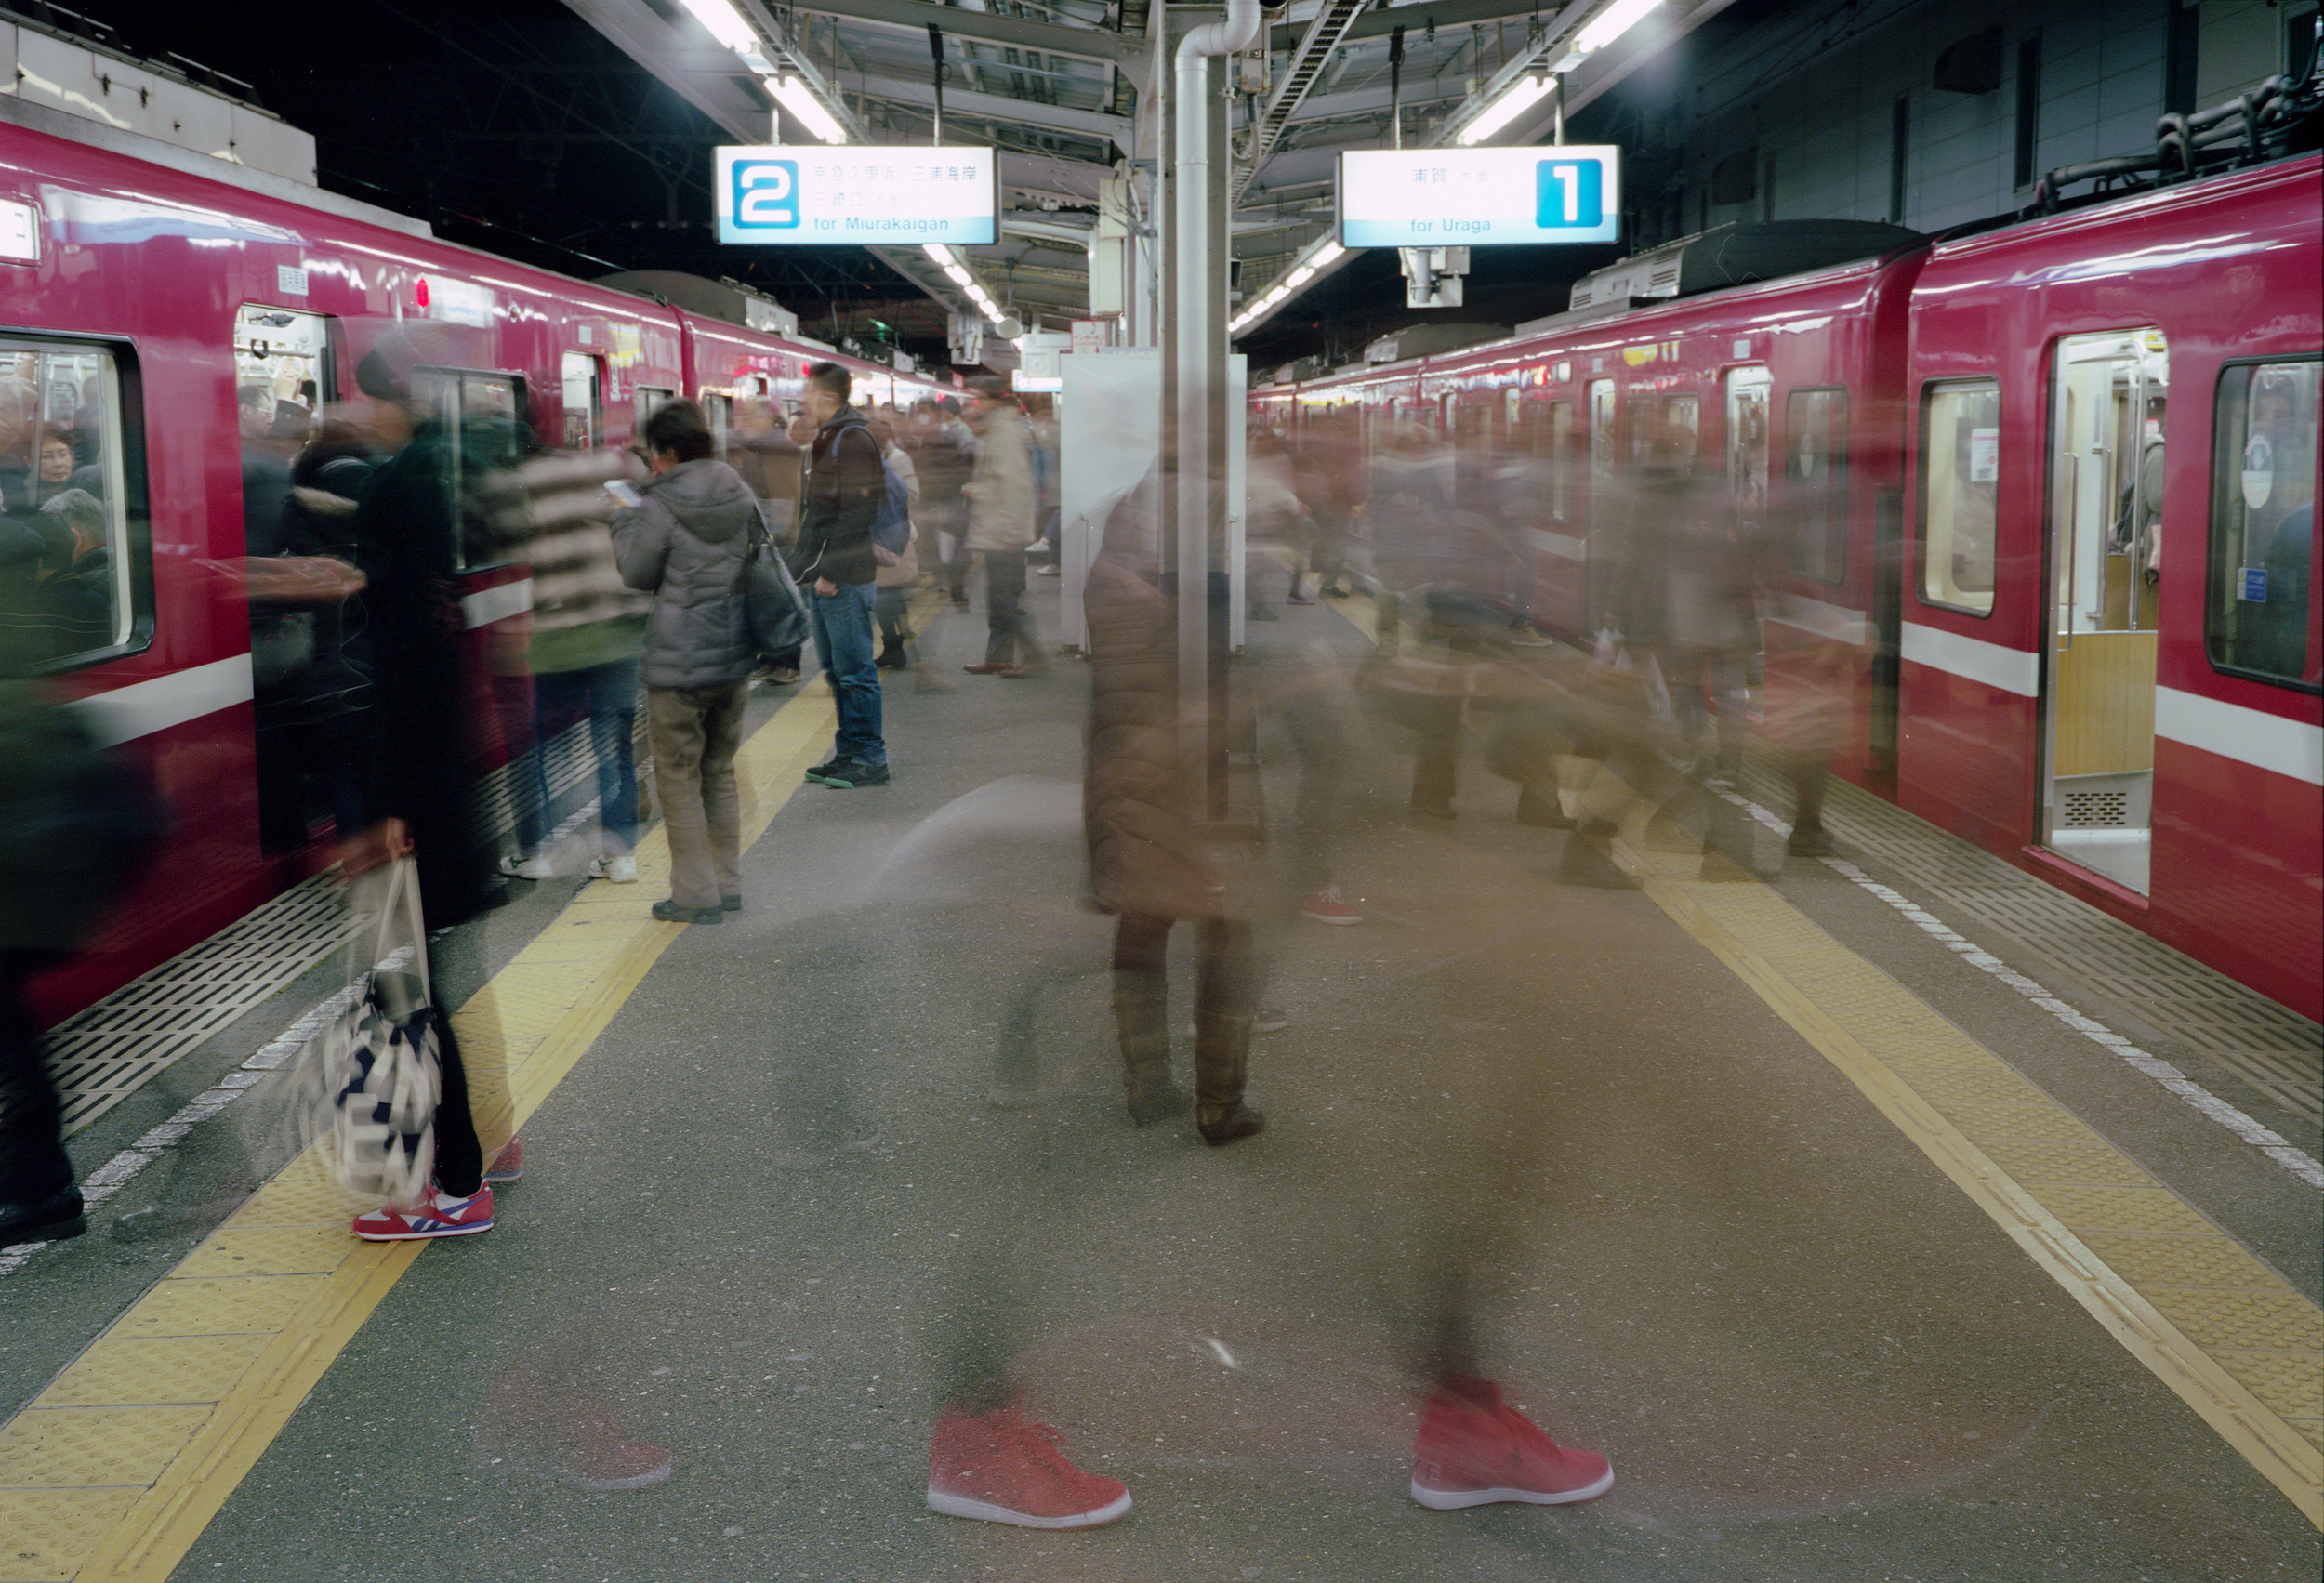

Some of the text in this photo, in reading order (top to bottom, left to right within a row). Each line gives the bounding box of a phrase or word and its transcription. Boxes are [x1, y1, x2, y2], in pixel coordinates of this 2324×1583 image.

[813, 165, 977, 181] 京急久里浜 三浦海岸
[1411, 167, 1447, 184] 浦賀
[741, 165, 791, 222] 2
[1553, 165, 1579, 222] 1
[814, 217, 949, 232] for Miurakaigan
[1410, 217, 1491, 234] for Uraga
